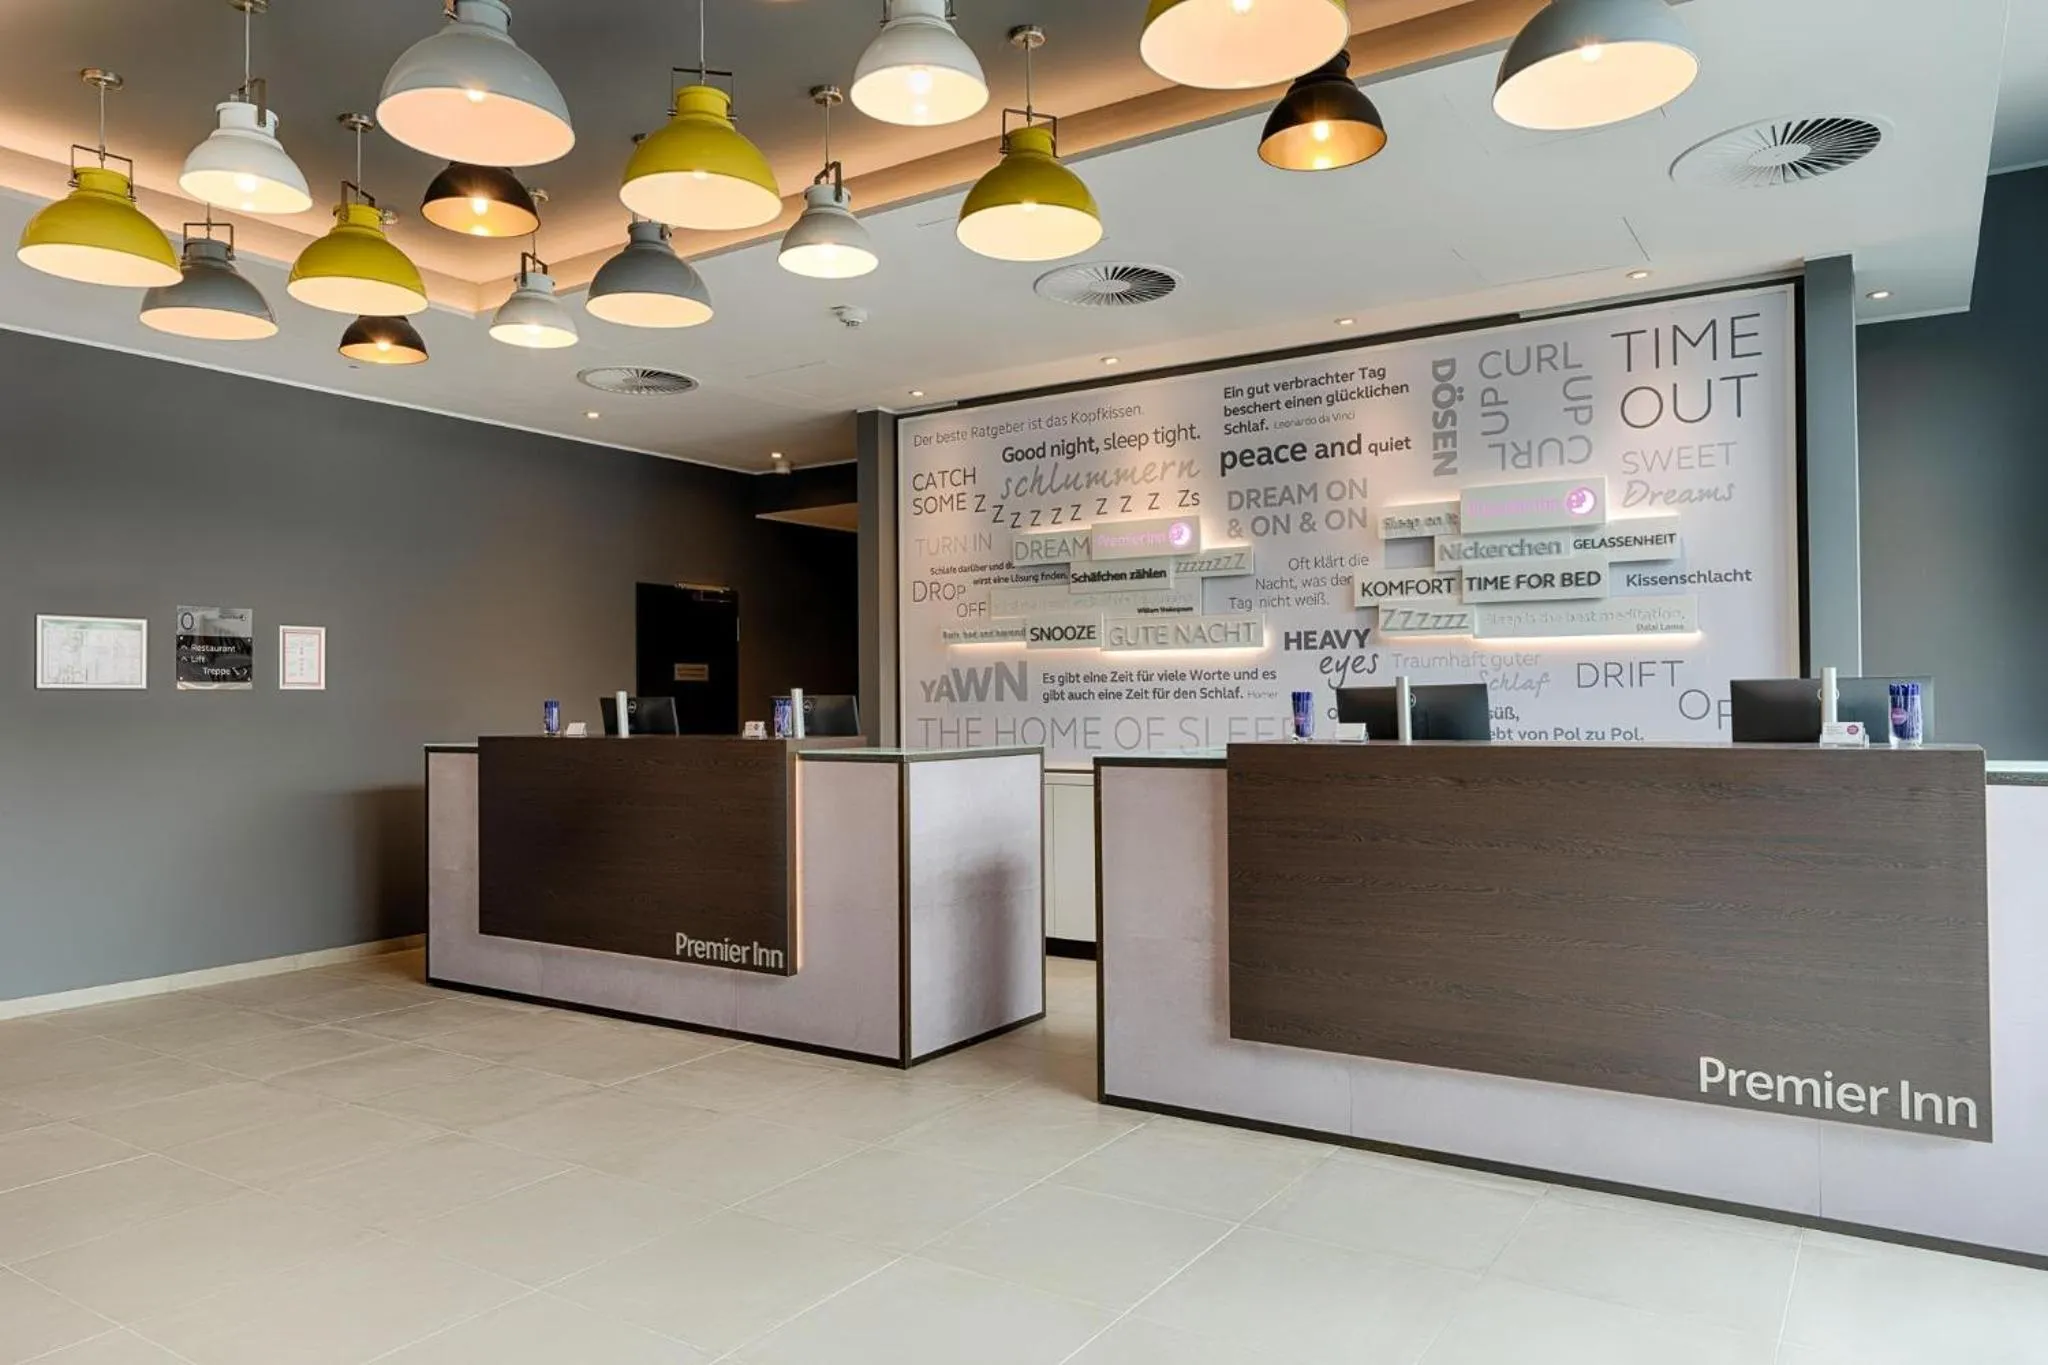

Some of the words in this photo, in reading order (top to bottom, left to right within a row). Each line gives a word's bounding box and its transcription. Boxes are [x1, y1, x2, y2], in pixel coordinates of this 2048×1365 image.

[1611, 313, 1762, 372] TIME
[1478, 342, 1583, 380] CURL
[1223, 387, 1244, 400] Ein
[1247, 383, 1270, 399] gut
[1273, 370, 1354, 392] verbrachter
[1359, 366, 1387, 382] Tag
[1224, 401, 1281, 417] beschert
[1284, 395, 1322, 410] einen
[1326, 382, 1409, 406] glücklichen
[1481, 387, 1510, 436] UP
[1562, 375, 1593, 426] UP
[1621, 373, 1758, 429] OUT
[913, 434, 933, 448] Der
[936, 430, 968, 443] beste
[971, 422, 1024, 439] Ratgeber
[1028, 417, 1042, 430] ist
[1046, 414, 1067, 428] das
[1071, 404, 1144, 425] Kopfkissen.
[1224, 419, 1269, 435] Schlaf.
[1273, 416, 1317, 430] Leonardo
[1318, 413, 1331, 425] da
[1332, 411, 1356, 423] Vinci
[1432, 357, 1464, 477] DÖSEN
[1002, 441, 1046, 463] Good
[1051, 436, 1100, 460] night,
[1103, 432, 1149, 451] sleep
[1153, 424, 1200, 448] tight.
[1220, 441, 1308, 477] peace
[1315, 433, 1362, 459] and
[1368, 436, 1412, 457] quiet
[1488, 435, 1593, 471] CURL
[1622, 441, 1738, 475] SWEET
[912, 467, 977, 492] CATCH
[1000, 459, 1201, 500] schlummern
[912, 493, 967, 516] SOME
[1227, 482, 1318, 511] DREAM
[1326, 478, 1368, 502] ON
[1622, 479, 1736, 508] Dreams
[1227, 518, 1245, 540] &
[1251, 514, 1291, 537] ON
[1299, 511, 1317, 533] &
[1325, 507, 1368, 531] ON
[915, 534, 971, 557] TURN
[973, 532, 992, 551] IN
[1014, 536, 1091, 561] DREAM
[1438, 538, 1562, 562] Nickerchen
[1573, 533, 1677, 550] GELASSENHEIT
[1288, 557, 1312, 572] Oft
[1313, 556, 1345, 569] klärt
[1349, 553, 1369, 567] die
[1071, 571, 1127, 584] Schäfchen
[1130, 567, 1167, 580] zählen
[1255, 576, 1298, 592] Nacht,
[1301, 576, 1327, 588] was
[1330, 572, 1353, 586] der
[1361, 577, 1456, 598] KOMFORT
[1465, 575, 1511, 592] TIME
[1516, 573, 1556, 590] FOR
[1561, 570, 1602, 588] BED
[1626, 568, 1753, 588] Kissenschlacht
[912, 580, 966, 603] DROP
[1229, 597, 1253, 612] Tag
[1259, 595, 1291, 609] nicht
[1294, 593, 1330, 607] weiß.
[956, 601, 986, 618] OFF
[1030, 624, 1096, 643] SNOOZE
[1109, 624, 1169, 647] GUTE
[1176, 621, 1257, 645] NACHT
[1284, 628, 1371, 651] HEAVY
[191, 644, 236, 653] Restaurant
[191, 655, 206, 663] Lift
[1391, 650, 1489, 670] Traumhaft
[1491, 652, 1542, 671] guter
[202, 667, 231, 676] Treppe
[919, 660, 1028, 702] YAWN
[1042, 673, 1056, 684] Es
[1058, 671, 1080, 687] gibt
[1083, 671, 1107, 683] eine
[1110, 670, 1134, 683] Zeit
[1136, 669, 1154, 682] für
[1157, 669, 1187, 682] viele
[1189, 669, 1230, 681] Worte
[1234, 668, 1259, 680] und
[1262, 669, 1277, 681] es
[1319, 653, 1379, 690] eyes
[1576, 660, 1685, 688] DRIFT
[1042, 689, 1066, 704] gibt
[1068, 688, 1095, 701] auch
[1098, 689, 1123, 701] eine
[1125, 688, 1150, 700] Zeit
[1152, 688, 1171, 700] für
[1174, 687, 1197, 700] den
[1200, 686, 1244, 700] Schlaf.
[917, 716, 983, 749] THE
[994, 716, 1101, 750] HOME
[1114, 716, 1166, 751] OF
[1518, 730, 1548, 741] von
[1553, 727, 1580, 741] Pol
[1585, 730, 1605, 741] zu
[1611, 727, 1644, 741] Pol.
[675, 931, 749, 964] Premier
[753, 941, 783, 969] Inn
[1699, 1055, 1889, 1116] Premier
[1899, 1079, 1978, 1129] Inn
